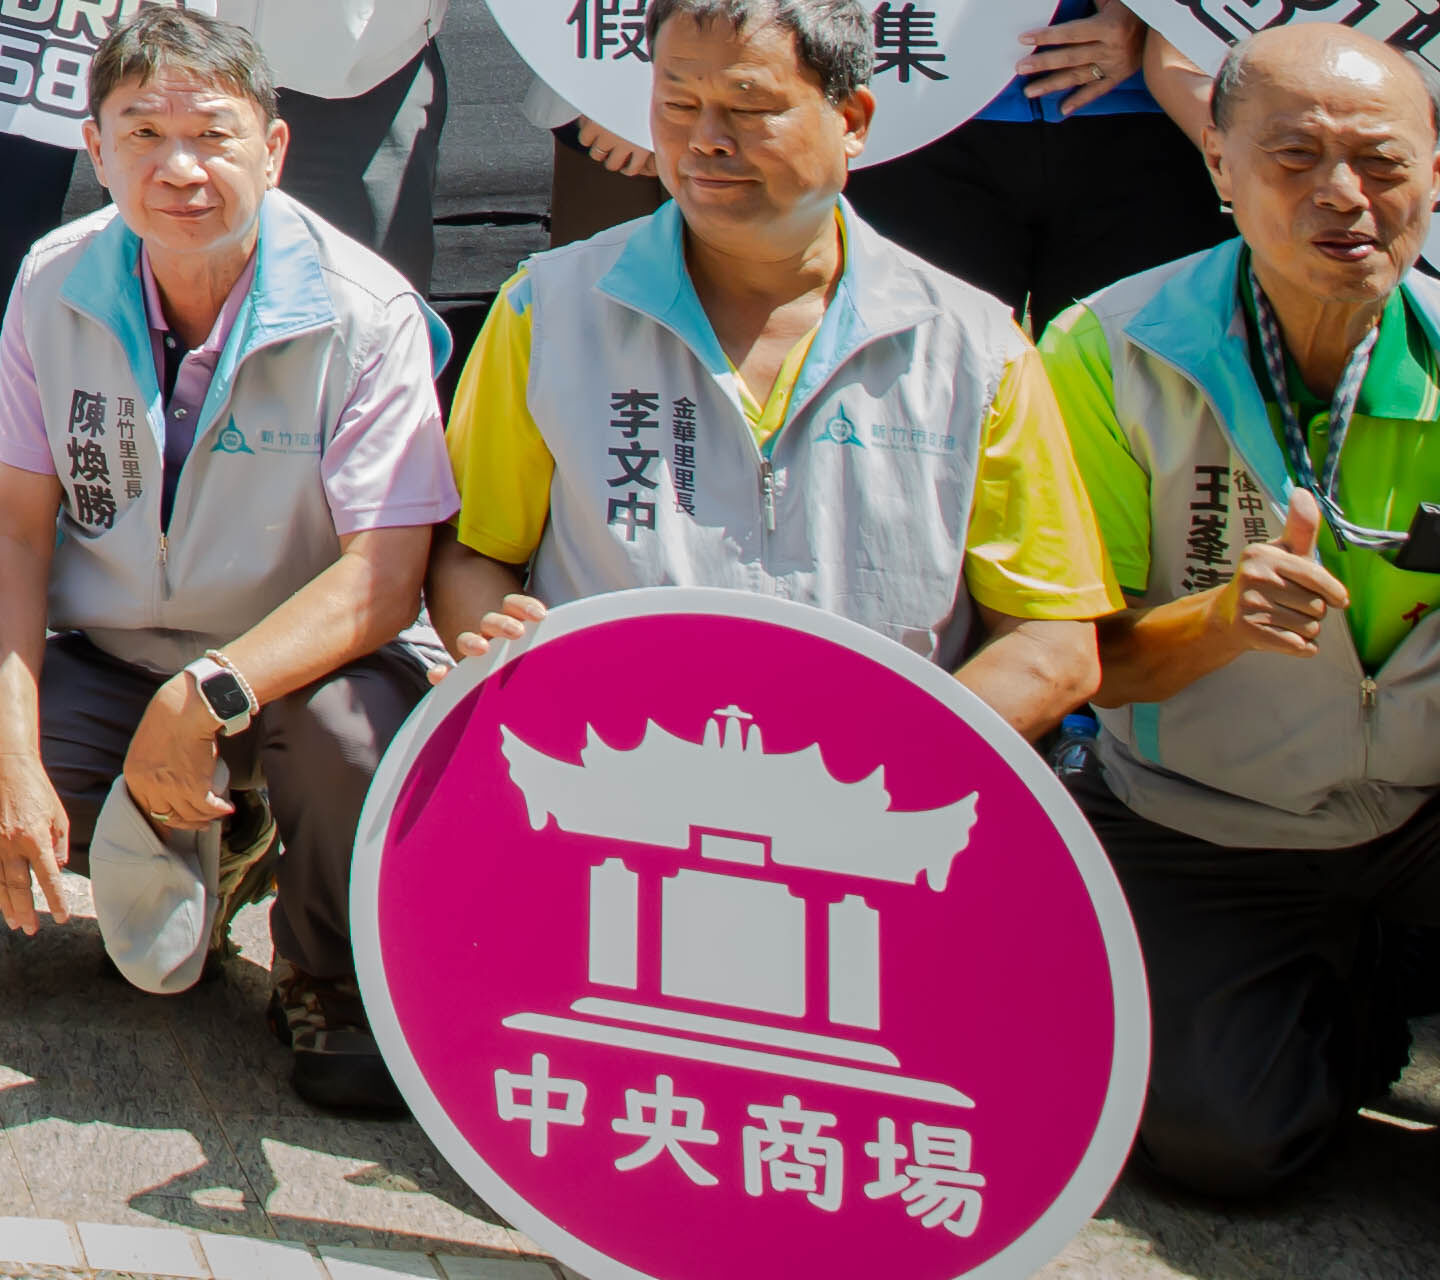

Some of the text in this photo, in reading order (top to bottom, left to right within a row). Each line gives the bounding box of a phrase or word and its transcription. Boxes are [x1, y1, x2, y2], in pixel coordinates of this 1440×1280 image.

[116, 396, 143, 499] 頂竹里里長
[608, 389, 660, 543] 李文中
[671, 396, 696, 517] 金華里里長
[493, 1052, 988, 1238] 中央商場
